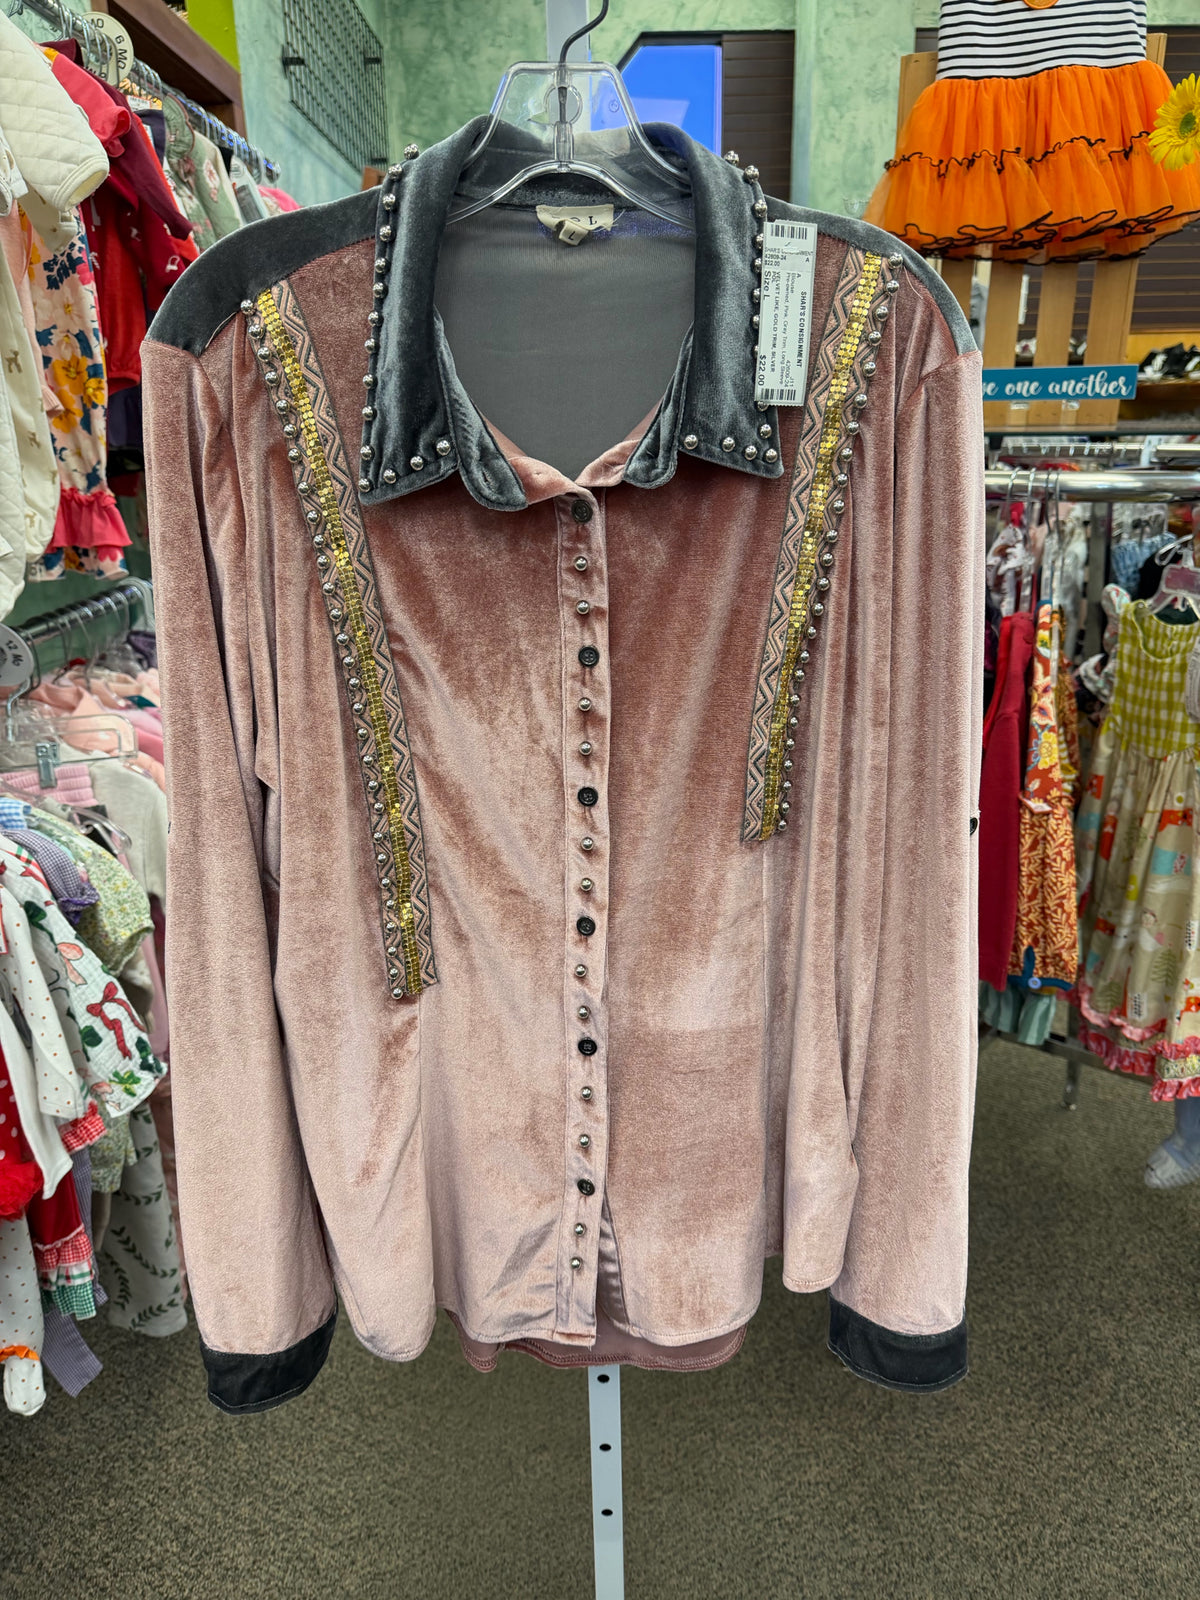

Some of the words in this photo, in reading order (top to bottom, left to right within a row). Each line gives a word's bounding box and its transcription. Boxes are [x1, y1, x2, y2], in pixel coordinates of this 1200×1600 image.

[115, 34, 125, 44] 6
[118, 48, 128, 70] MO
[568, 231, 576, 241] L
[763, 271, 771, 292] Size
[799, 291, 807, 317] SHAR'S
[796, 317, 806, 368] CONSIGNMENT
[757, 354, 767, 386] $22.00
[1004, 380, 1043, 397] one
[1047, 369, 1132, 397] another
